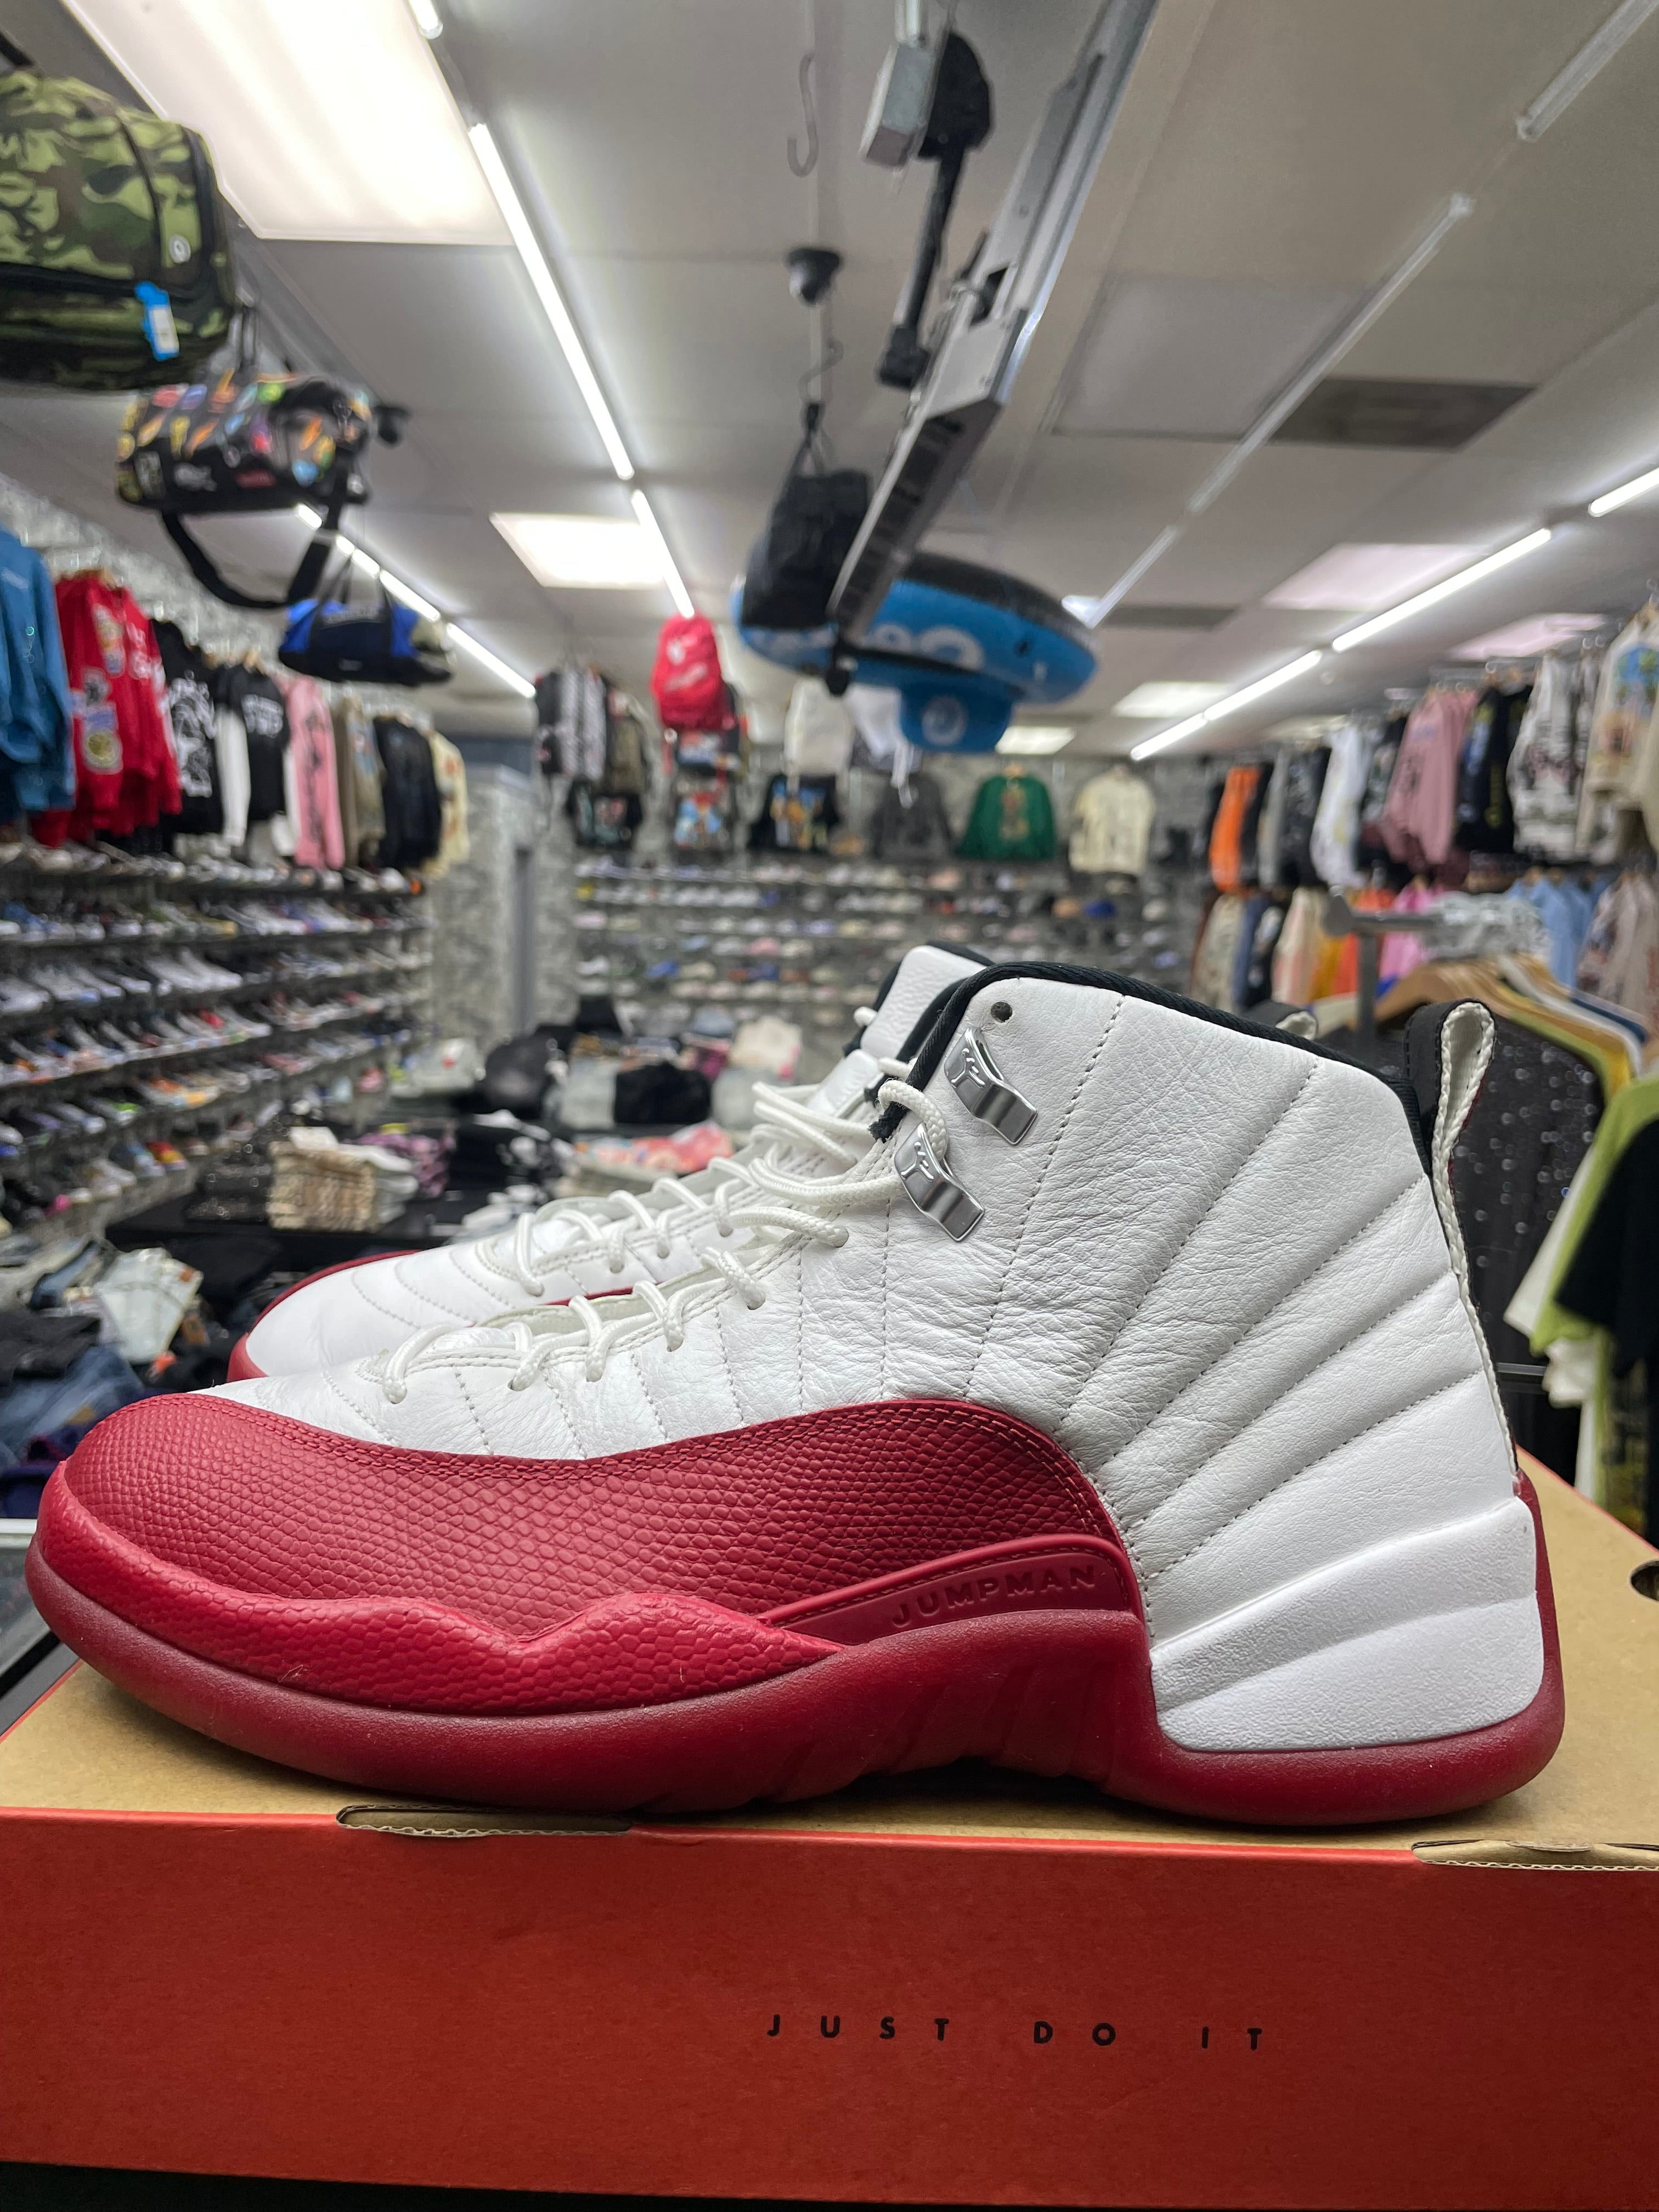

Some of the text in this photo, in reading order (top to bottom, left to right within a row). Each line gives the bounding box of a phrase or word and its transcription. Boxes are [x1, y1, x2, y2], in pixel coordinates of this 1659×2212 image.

[892, 1565, 1095, 1627] JUMPMAN
[766, 2014, 1263, 2051] JUST DO IT
